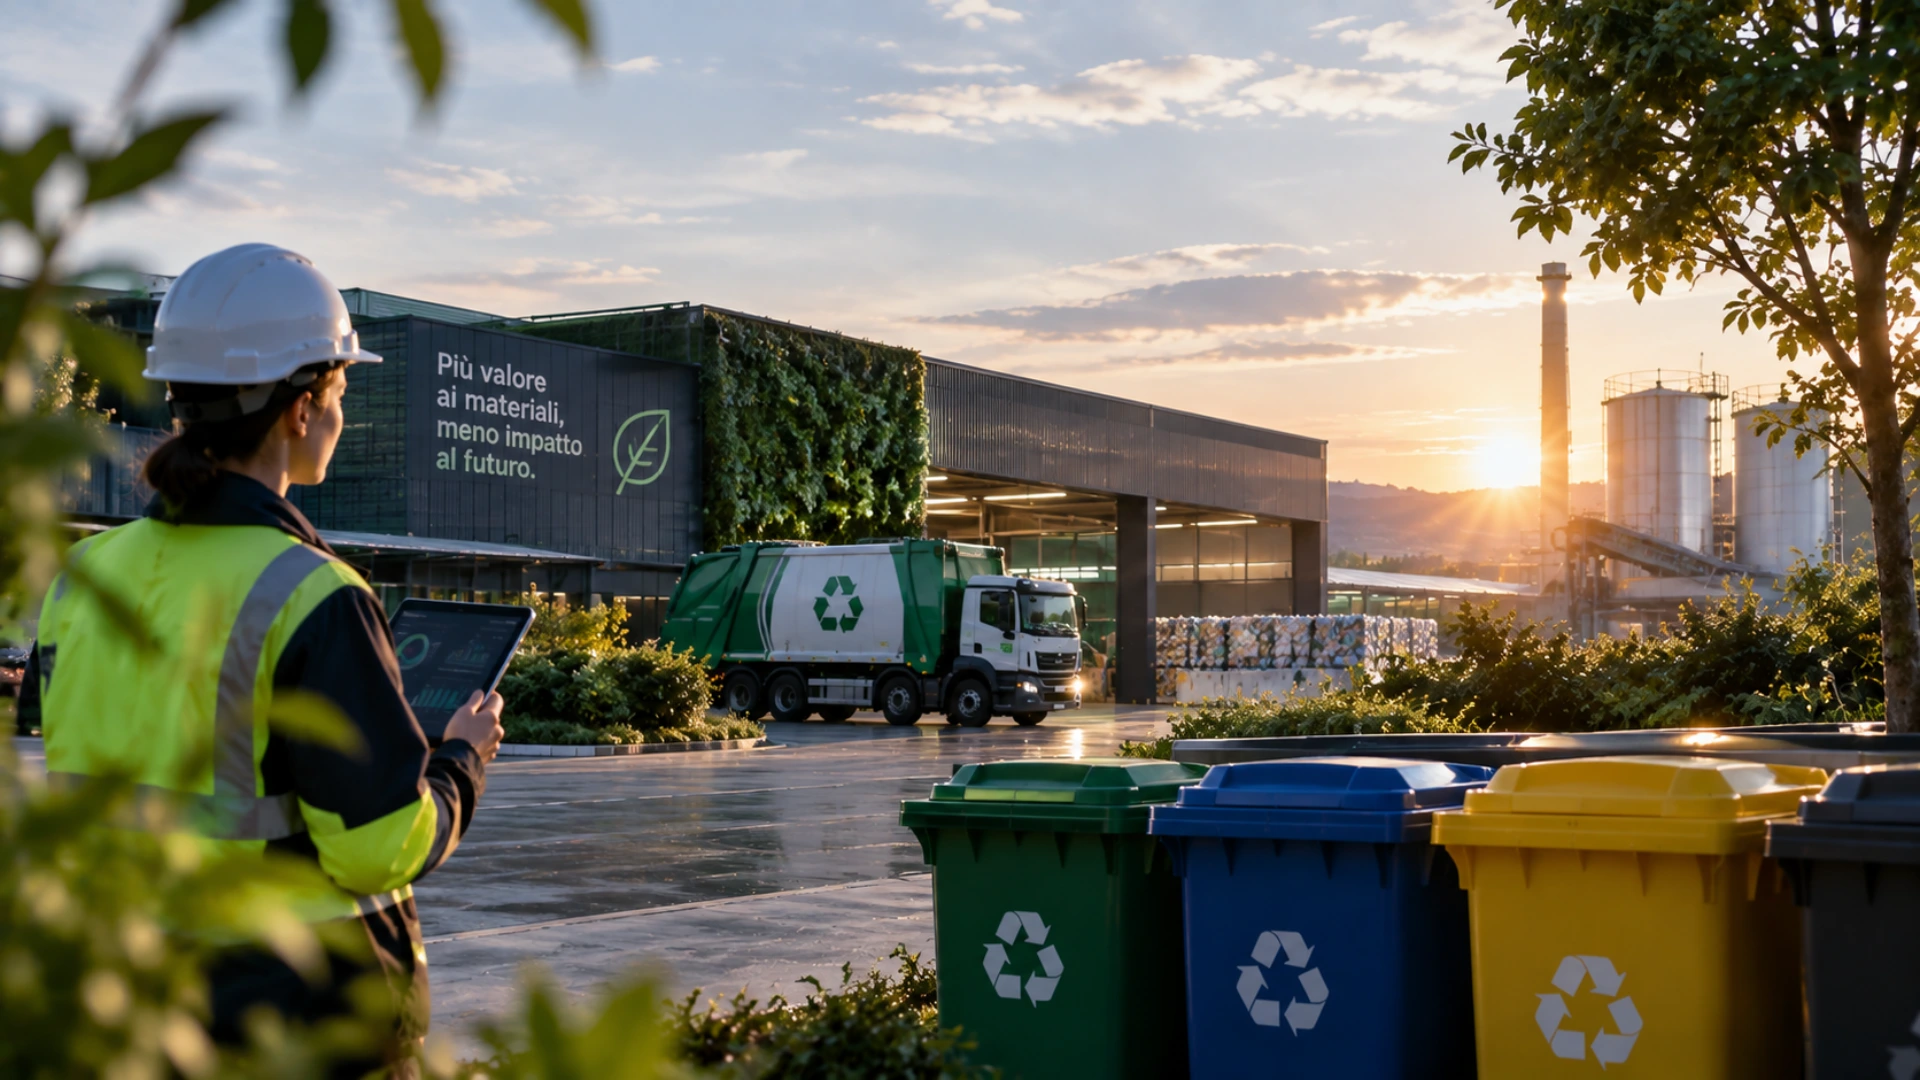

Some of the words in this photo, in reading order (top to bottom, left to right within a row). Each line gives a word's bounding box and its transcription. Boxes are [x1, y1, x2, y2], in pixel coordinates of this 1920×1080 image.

[437, 352, 473, 380] Più
[480, 363, 547, 392] valore
[436, 385, 456, 408] ai
[465, 392, 565, 427] materiali,
[437, 419, 499, 445] meno
[505, 424, 583, 456] impatto
[436, 447, 456, 471] al
[464, 449, 536, 479] futuro.
